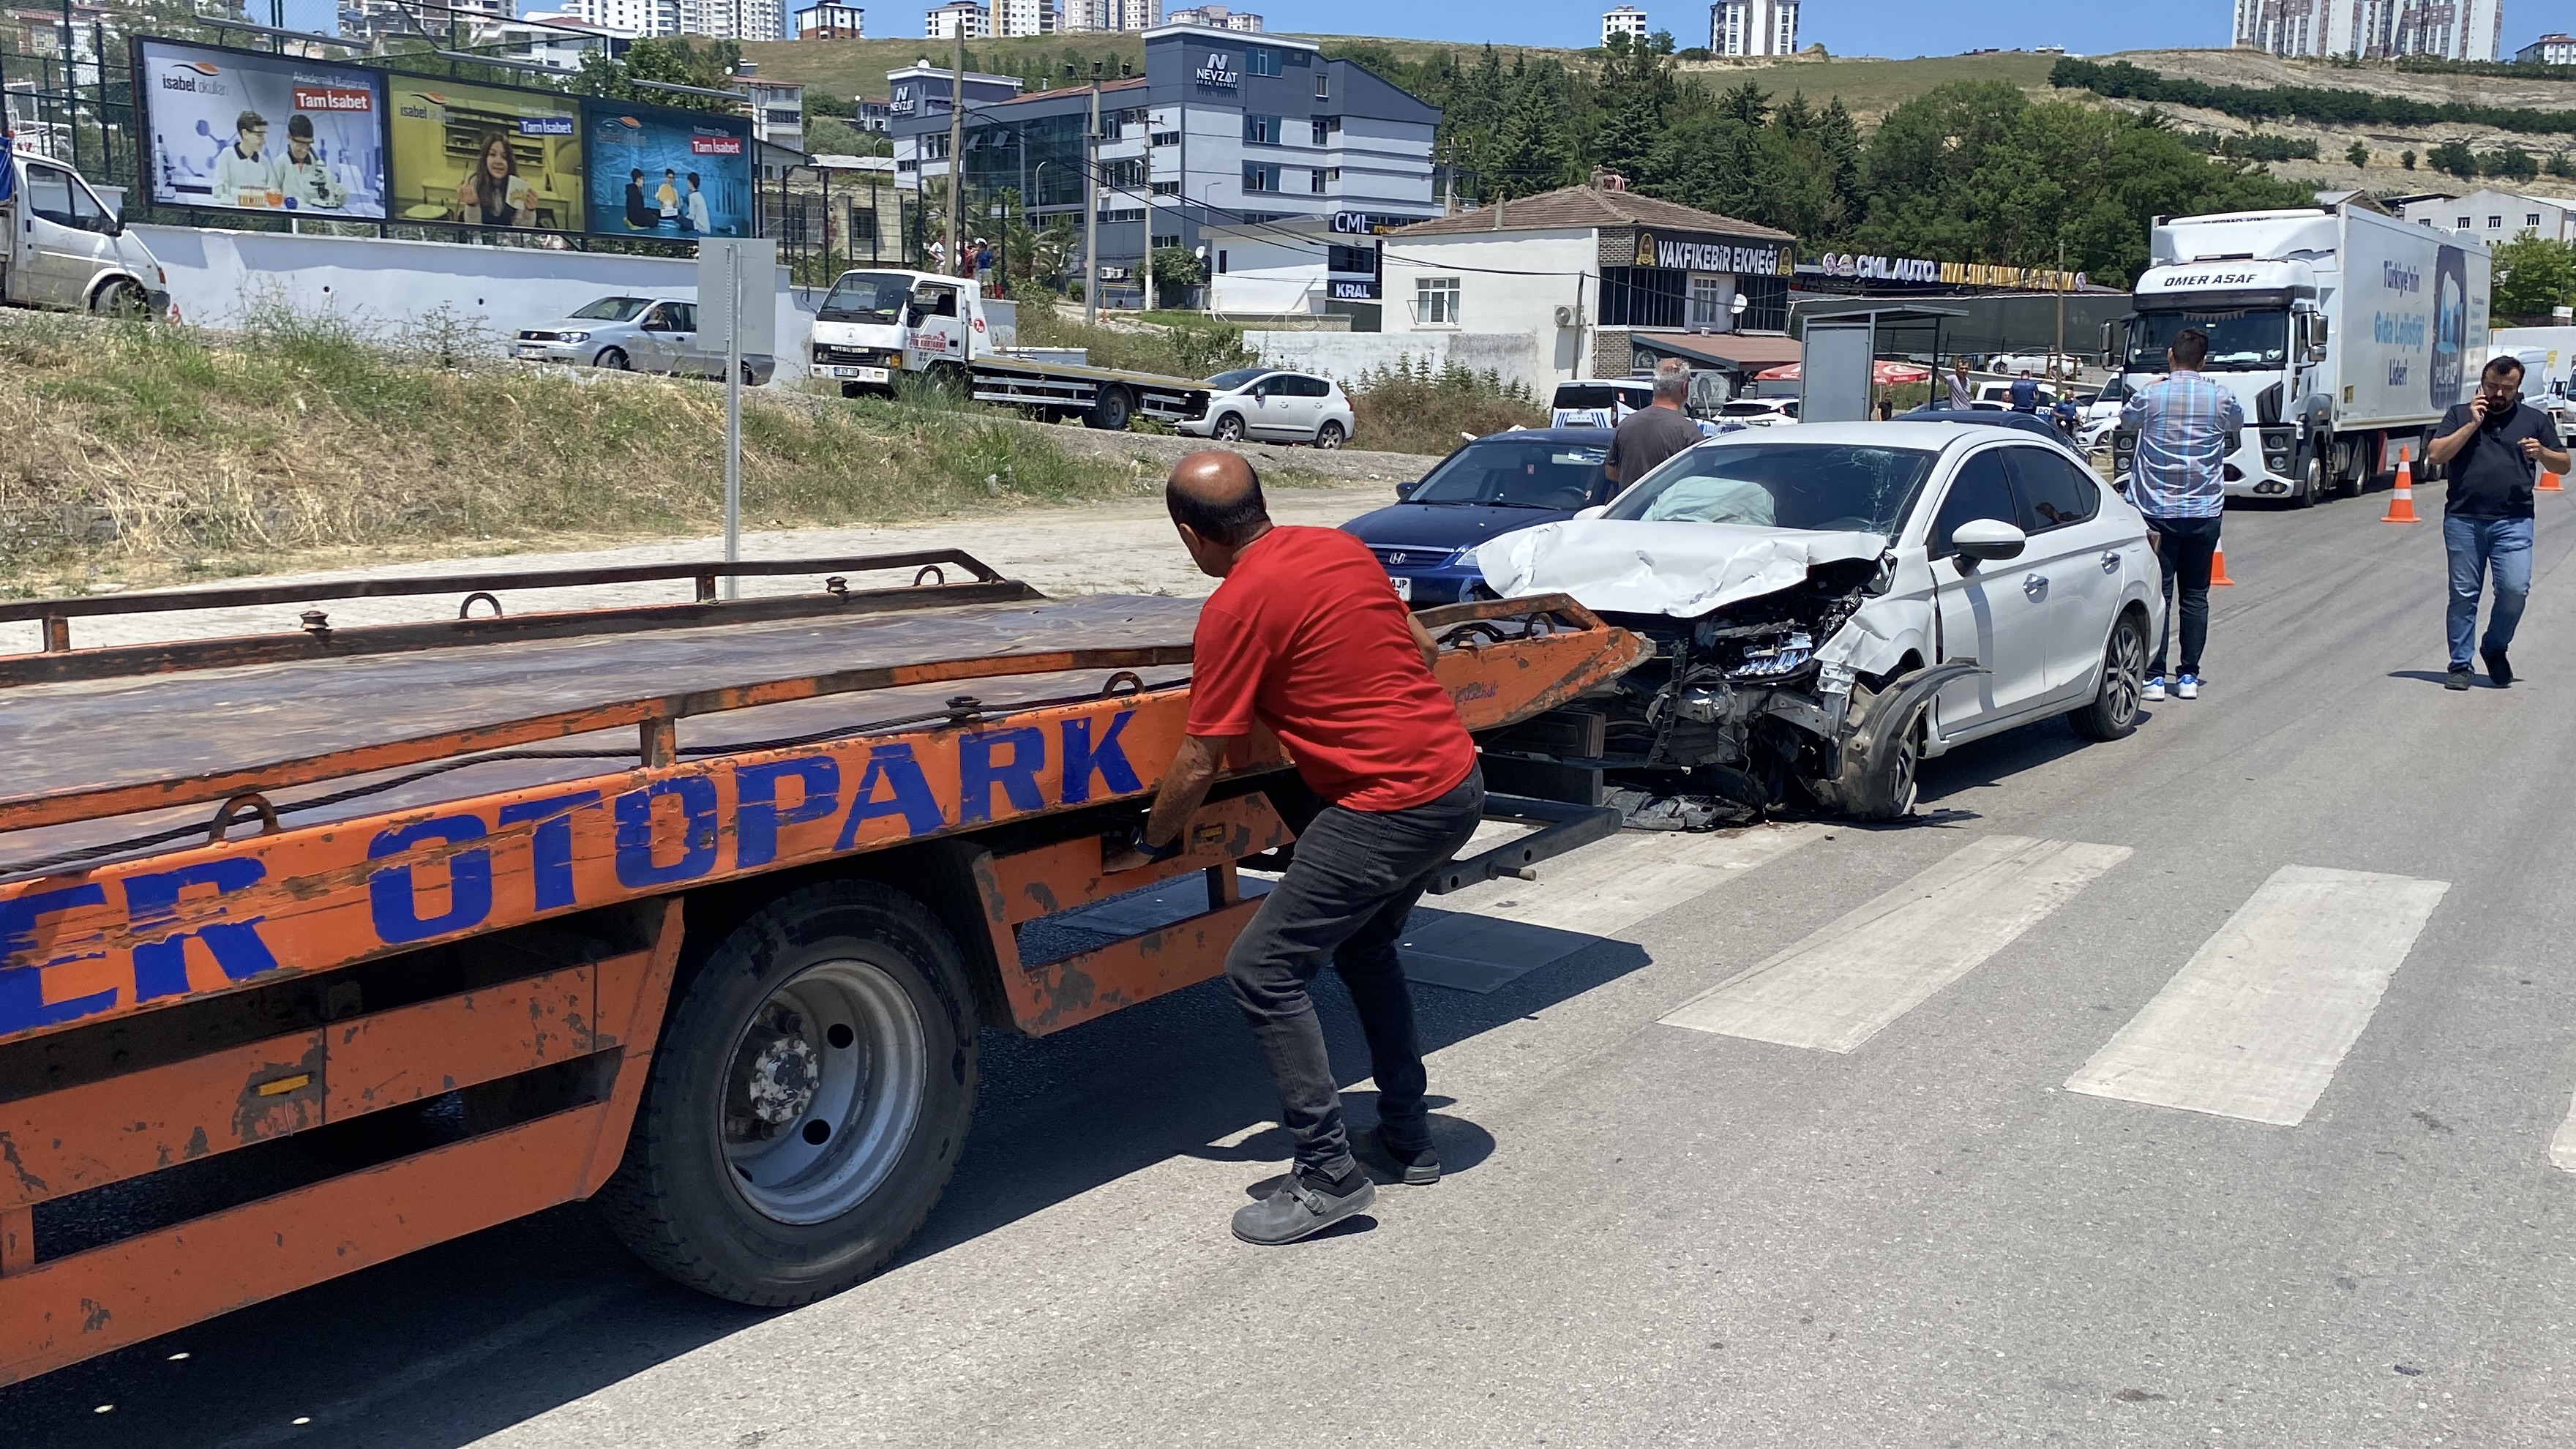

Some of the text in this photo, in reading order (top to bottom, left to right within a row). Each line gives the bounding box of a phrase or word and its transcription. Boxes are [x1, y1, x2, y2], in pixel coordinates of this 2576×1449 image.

[162, 74, 196, 92] isabet
[1197, 68, 1238, 83] NEVZAT
[297, 90, 367, 109] Tam İsabet
[890, 100, 914, 111] NEVZAT
[400, 104, 427, 119] isabet
[521, 121, 542, 132] Tam
[692, 141, 713, 152] Tam
[1334, 211, 1370, 233] CML
[1856, 255, 1892, 279] CML
[1892, 258, 1935, 282] AUTO
[2211, 274, 2258, 285] ASAF
[1336, 283, 1371, 298] KRAL
[2389, 357, 2408, 386] Lideri
[367, 711, 1143, 944] OTOPARK
